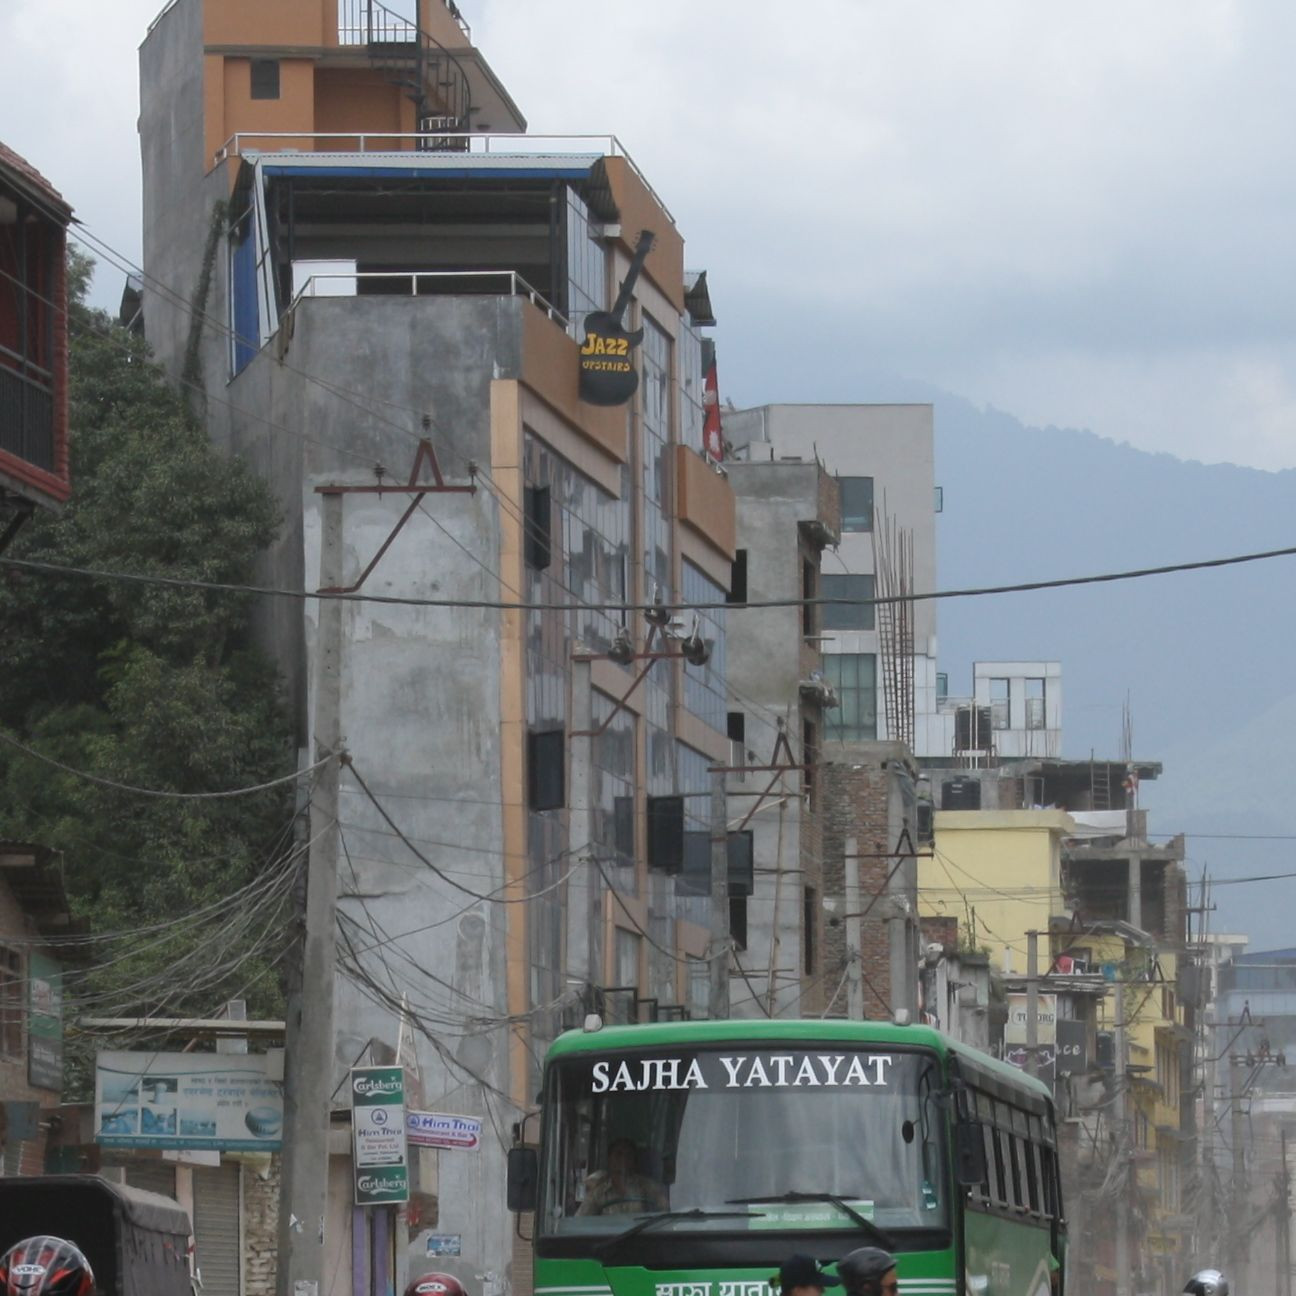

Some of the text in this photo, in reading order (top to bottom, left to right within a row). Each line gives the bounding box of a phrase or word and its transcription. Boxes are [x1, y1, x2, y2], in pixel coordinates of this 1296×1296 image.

[582, 360, 630, 372] UPSTAIRS
[591, 1055, 892, 1093] SAJHA YATAYAT
[353, 1076, 402, 1095] Carlsberg
[358, 1127, 402, 1137] Him Thai
[422, 1118, 480, 1132] Him Thai
[357, 1174, 407, 1194] Carlsberg
